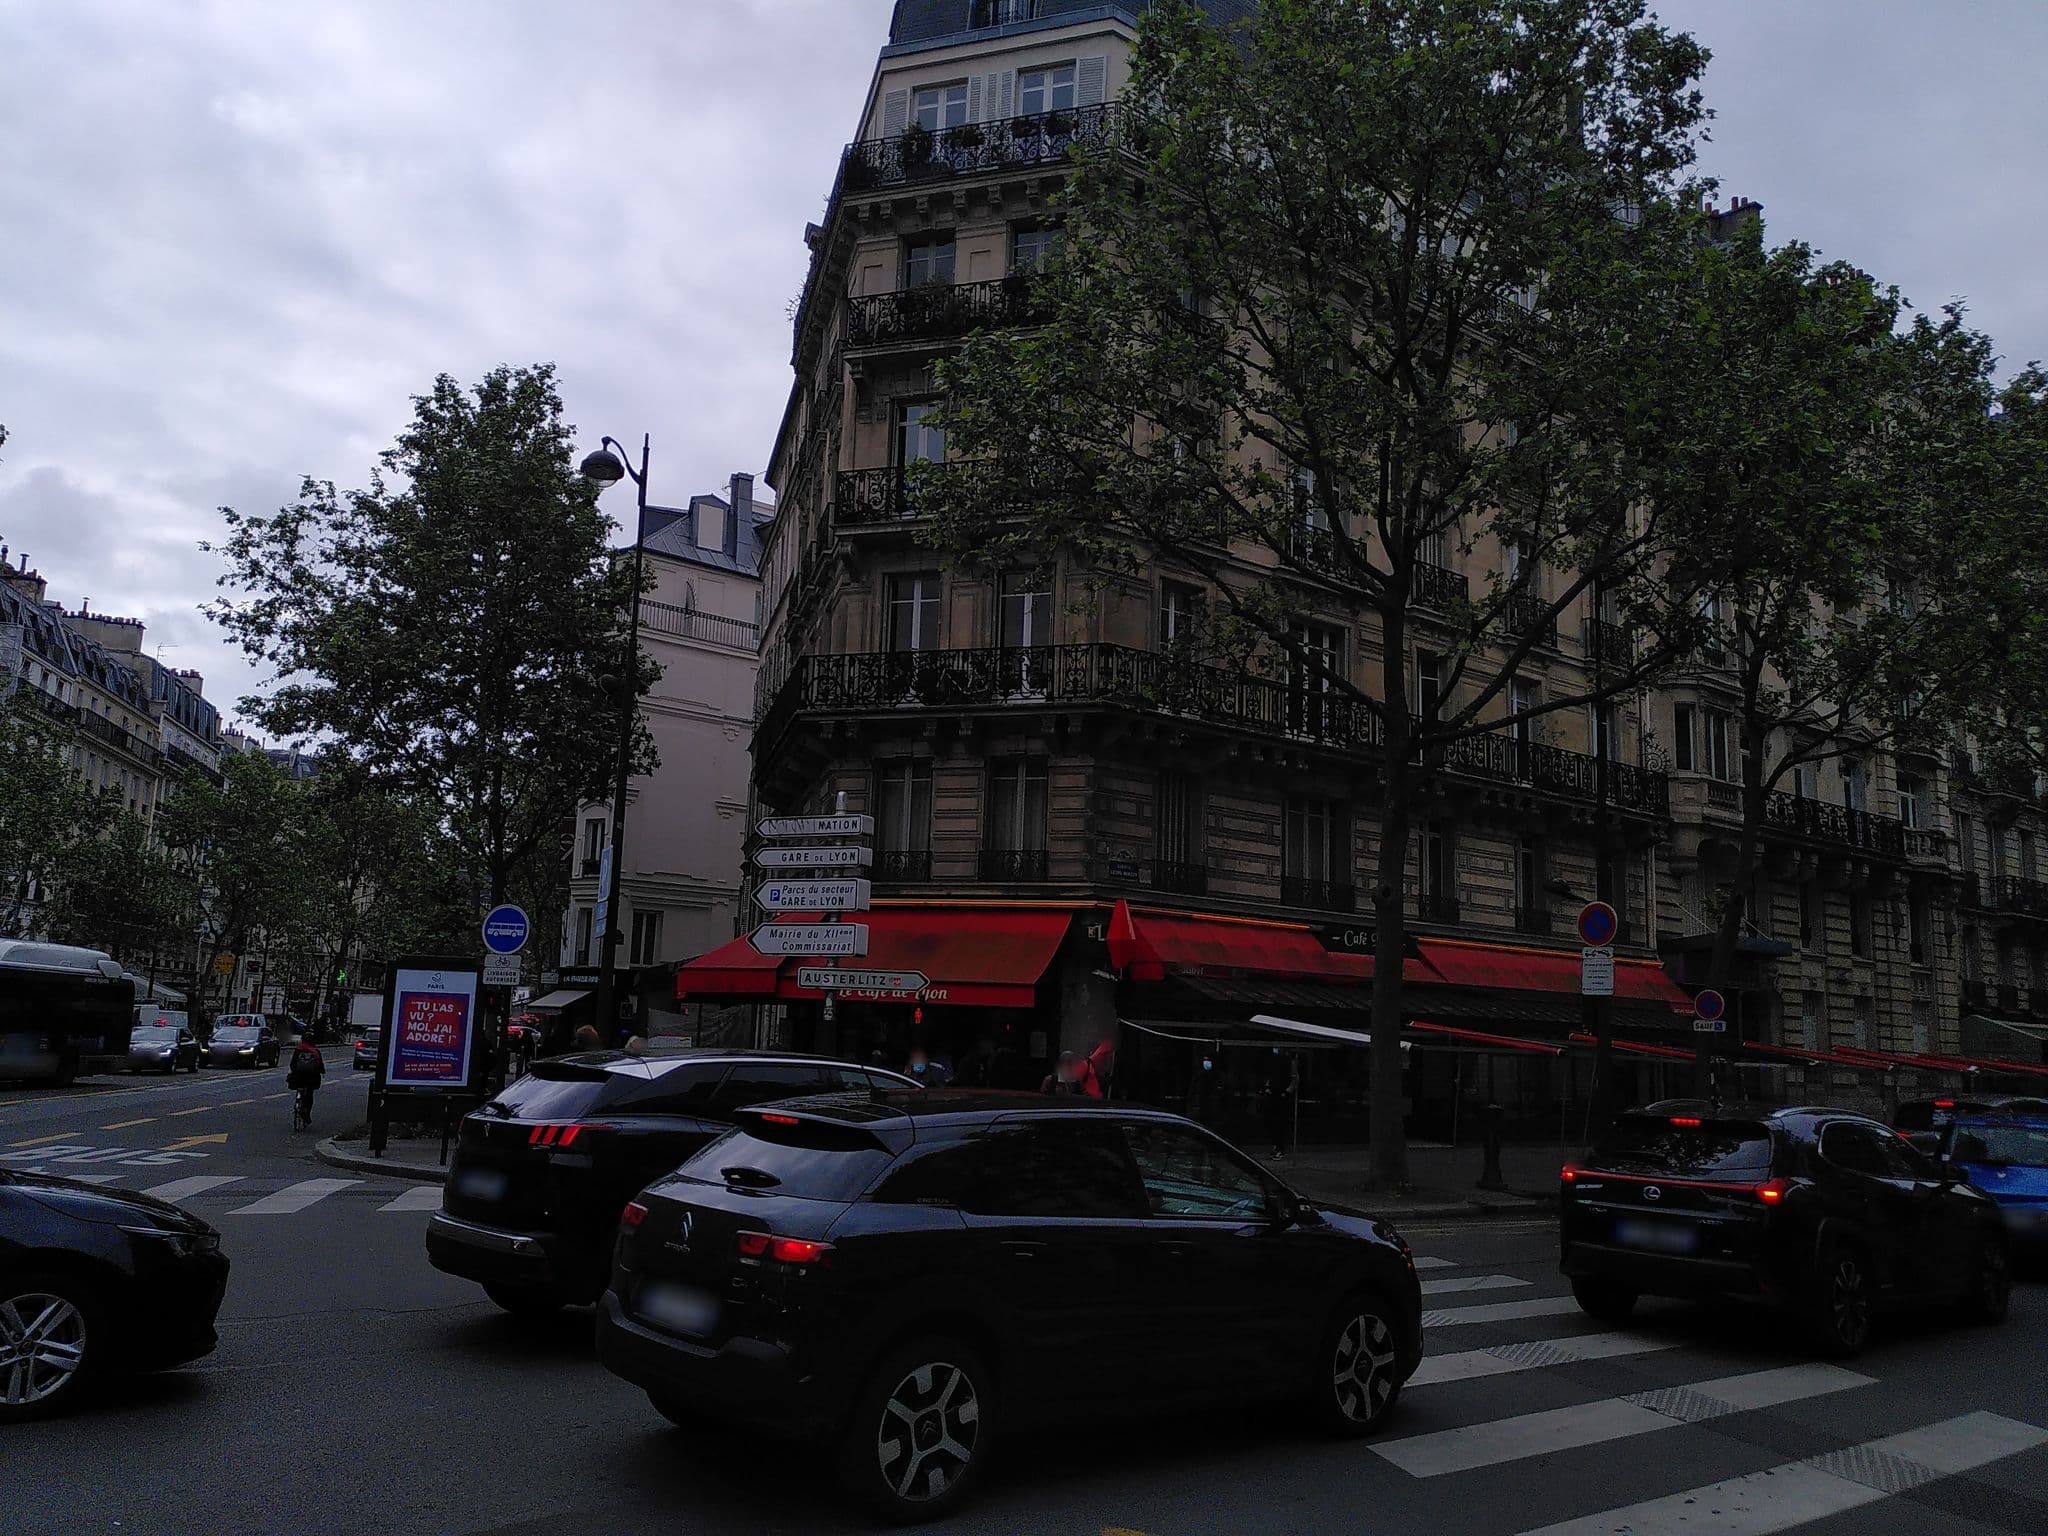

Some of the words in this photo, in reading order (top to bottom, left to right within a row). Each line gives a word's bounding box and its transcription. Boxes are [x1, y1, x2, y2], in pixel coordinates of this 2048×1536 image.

[782, 853, 809, 862] GARE
[829, 852, 855, 861] LYON
[783, 885, 805, 894] Parcs
[809, 885, 818, 894] du
[821, 886, 854, 894] secteur
[781, 897, 806, 906] GARE
[820, 897, 844, 906] LYON
[770, 929, 801, 938] Mairie
[808, 930, 818, 938] du
[1344, 930, 1368, 947] Café
[782, 941, 851, 951] Commissariat
[805, 973, 886, 985] AUSTERLITZ
[432, 1003, 455, 1013] L'AS
[409, 1011, 424, 1021] VU
[427, 1012, 434, 1022] ?
[433, 1023, 453, 1034] J'AI
